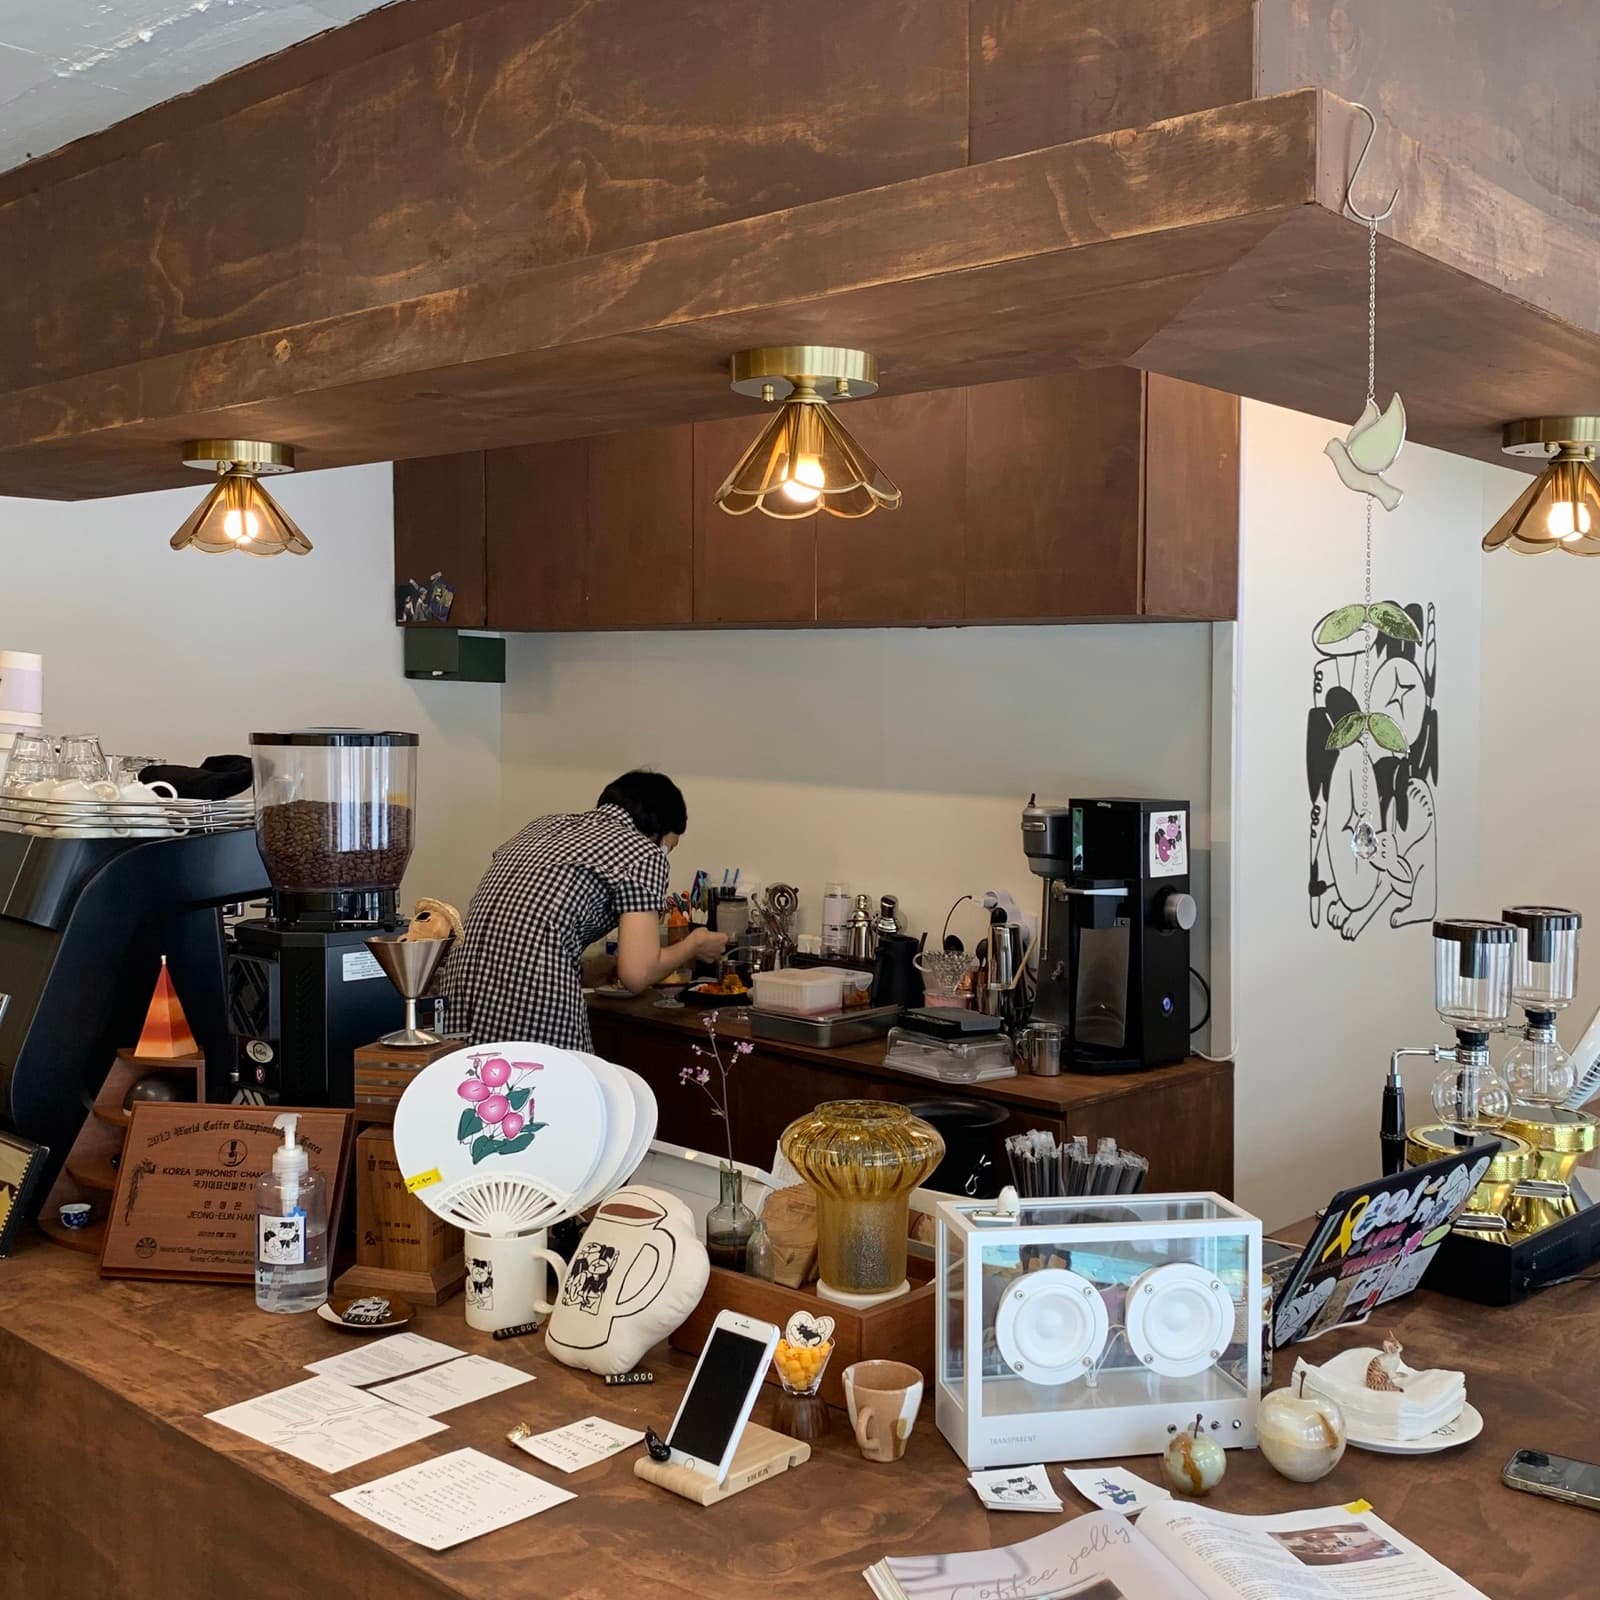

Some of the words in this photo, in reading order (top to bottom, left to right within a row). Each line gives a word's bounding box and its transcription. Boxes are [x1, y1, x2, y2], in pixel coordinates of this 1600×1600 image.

[203, 1120, 230, 1132] Coffee
[162, 1167, 191, 1176] KOREA
[194, 1169, 238, 1178] SIPHONIST
[236, 1213, 255, 1221] HAN
